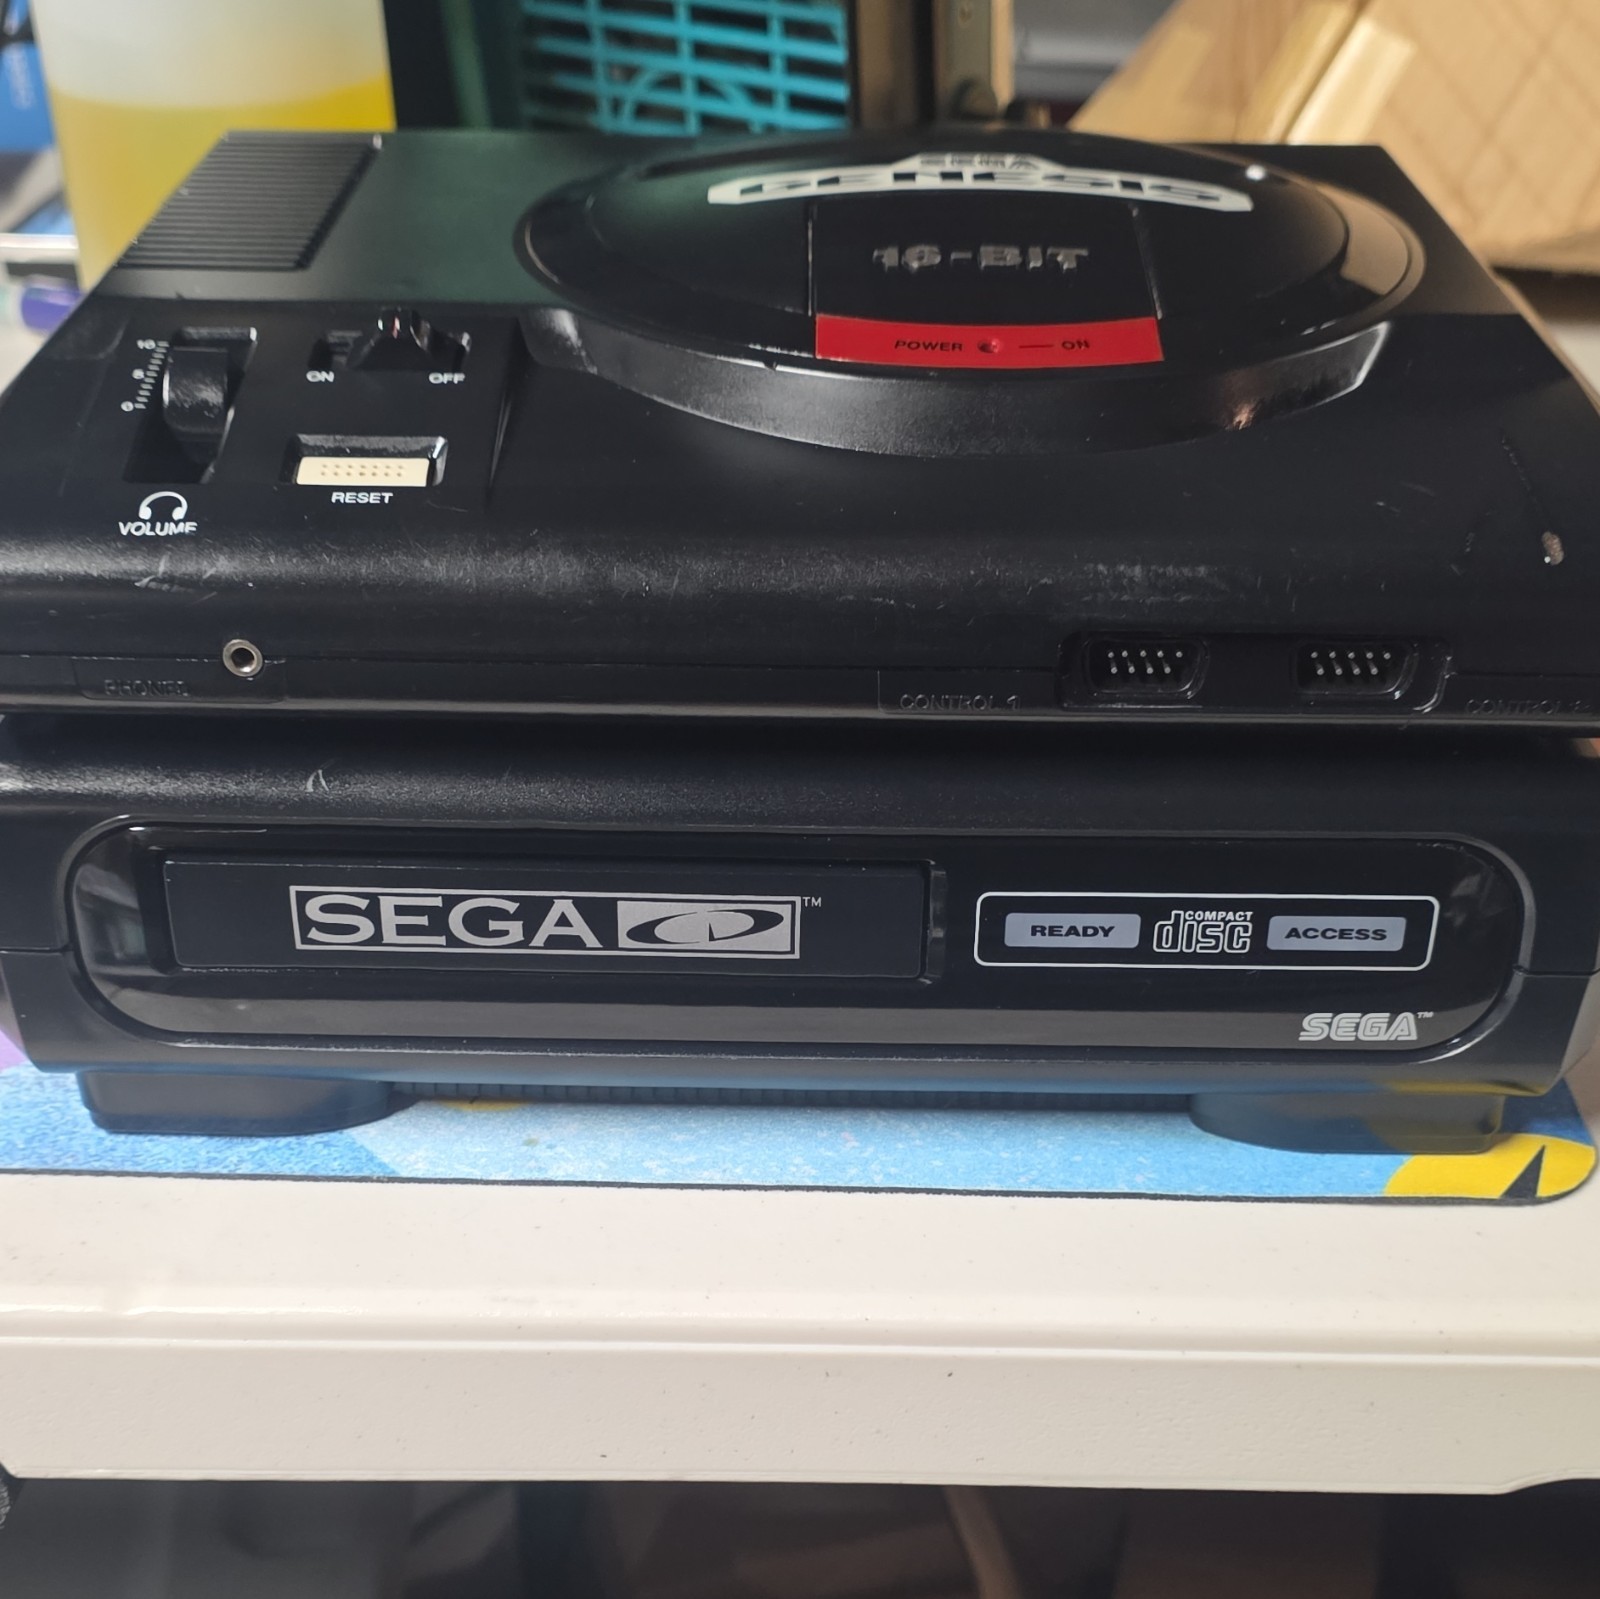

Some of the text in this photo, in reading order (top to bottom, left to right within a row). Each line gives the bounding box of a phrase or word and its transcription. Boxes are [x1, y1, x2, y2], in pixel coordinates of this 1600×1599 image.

[894, 338, 1091, 352] POWER ON
[305, 370, 466, 385] ON OFF
[331, 491, 394, 505] RESET
[118, 521, 198, 536] VOLUME
[899, 693, 1001, 712] CONTROL
[304, 894, 604, 949] SEGA
[1184, 910, 1254, 922] COMPACT
[1029, 924, 1116, 939] READY
[1152, 910, 1252, 954] disc
[1284, 927, 1388, 942] ACCESS
[1298, 1011, 1418, 1042] SEGA
